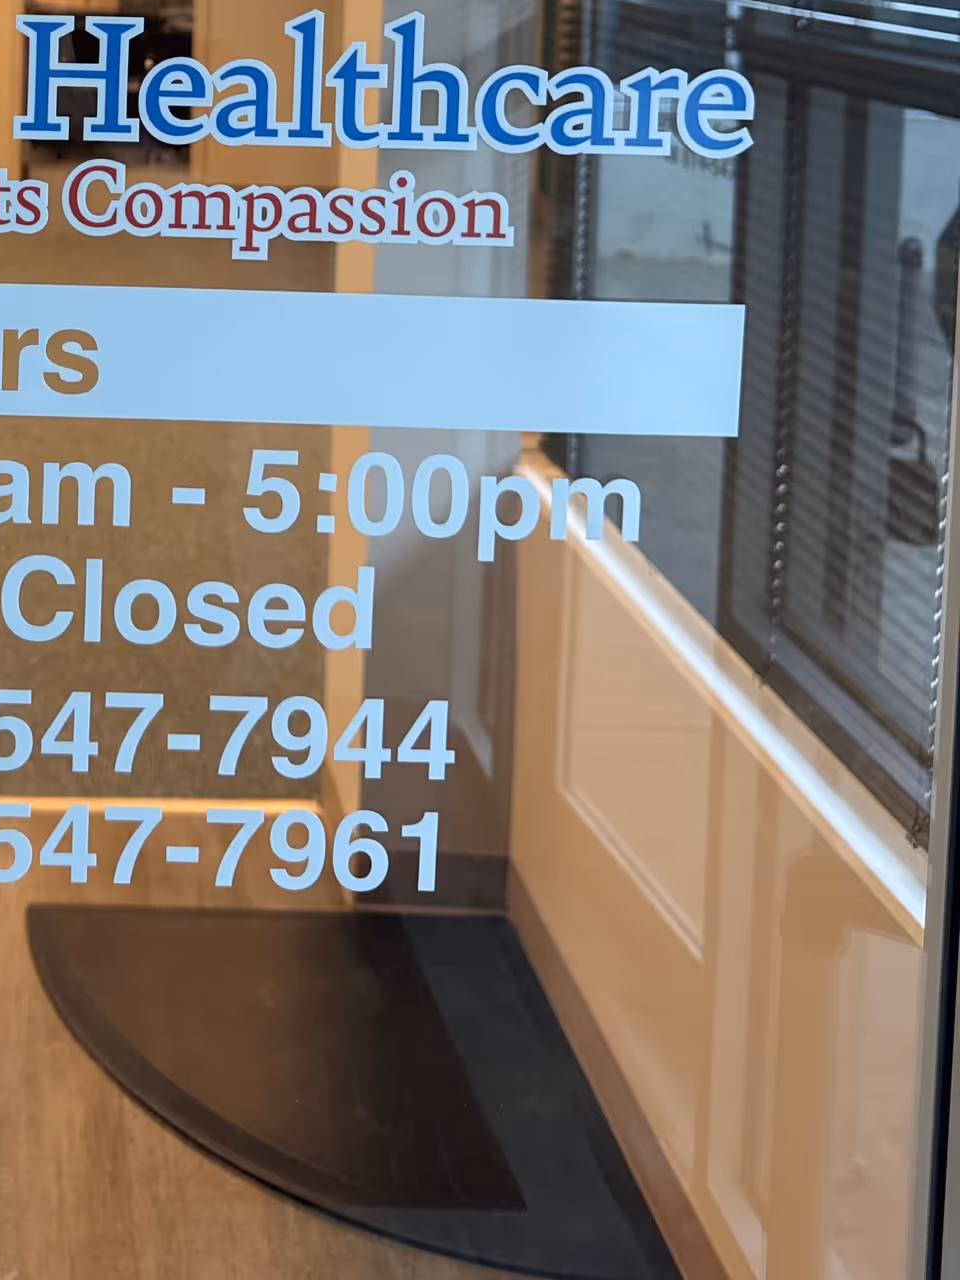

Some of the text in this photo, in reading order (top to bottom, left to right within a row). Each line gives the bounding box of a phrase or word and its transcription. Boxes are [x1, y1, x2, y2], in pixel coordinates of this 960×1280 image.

[14, 10, 754, 157] Healthcare
[66, 161, 511, 256] Compassion
[171, 487, 206, 504] -
[242, 449, 642, 562] 5:00pm
[0, 554, 376, 651] Closed
